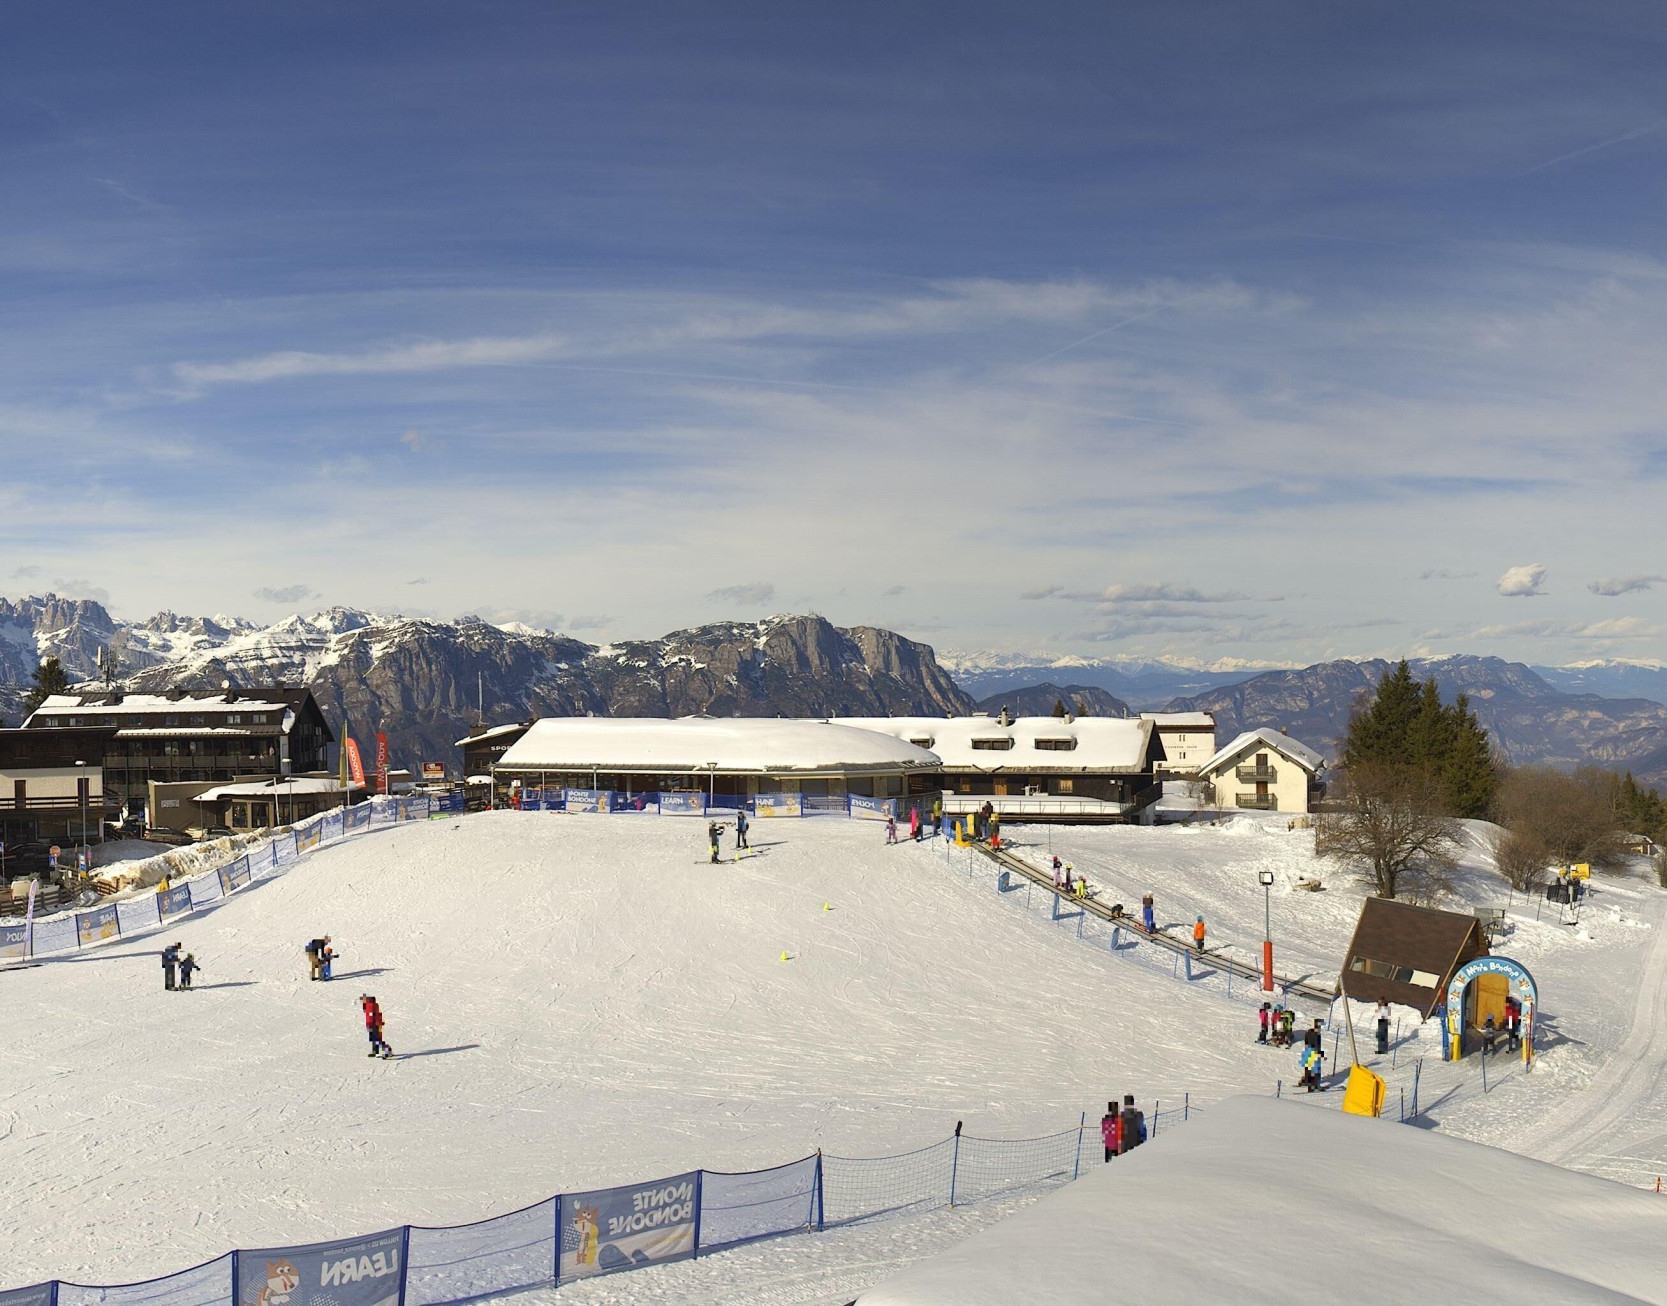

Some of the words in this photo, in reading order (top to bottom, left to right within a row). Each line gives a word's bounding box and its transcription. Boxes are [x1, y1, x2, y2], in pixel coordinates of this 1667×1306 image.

[568, 790, 589, 798] MONTE
[567, 795, 596, 803] BONDONE
[661, 797, 684, 805] LEARN
[851, 799, 876, 809] ENJOY
[1466, 962, 1488, 976] Monte
[1489, 962, 1519, 977] Bondone
